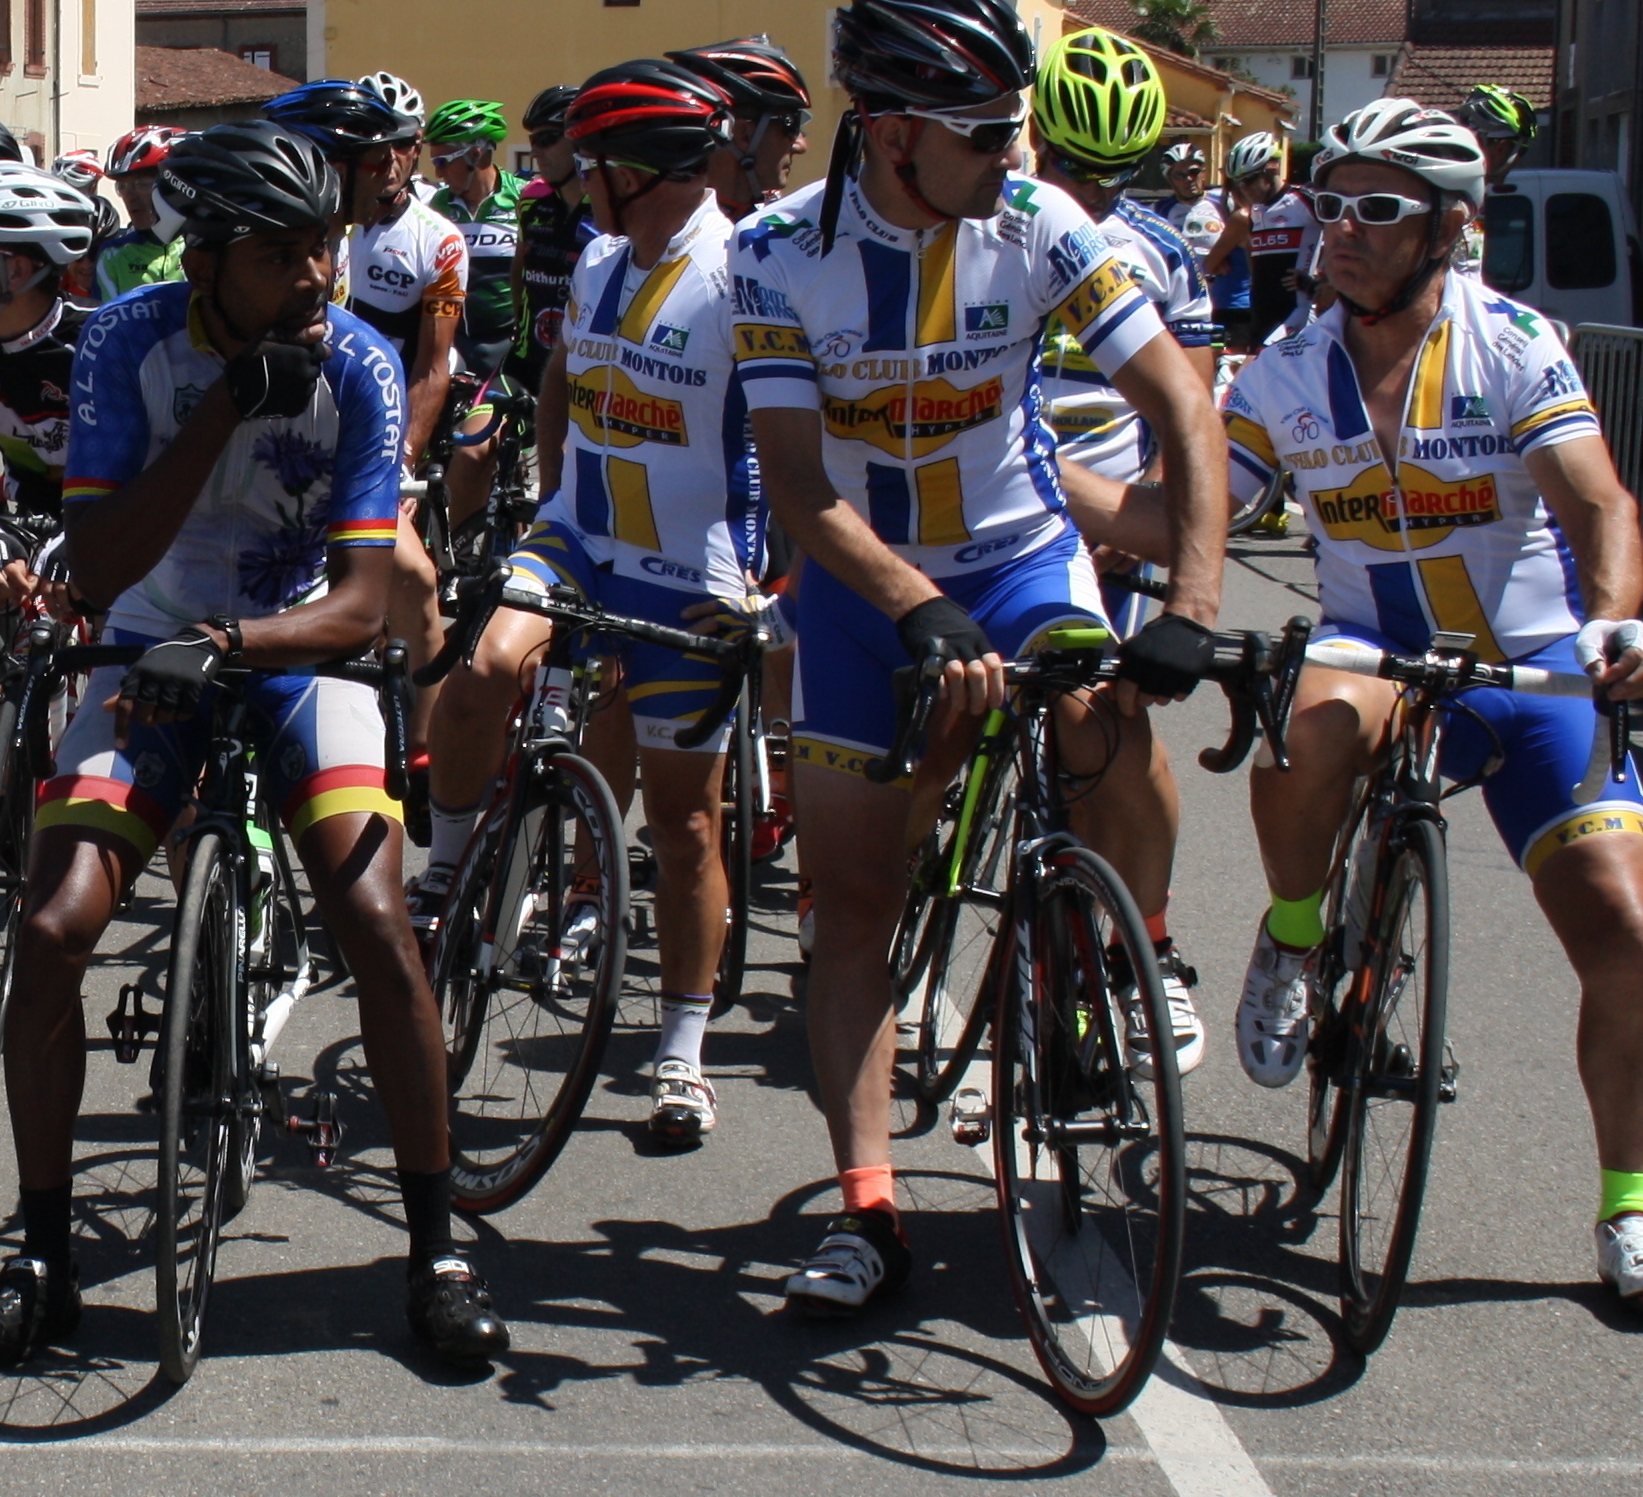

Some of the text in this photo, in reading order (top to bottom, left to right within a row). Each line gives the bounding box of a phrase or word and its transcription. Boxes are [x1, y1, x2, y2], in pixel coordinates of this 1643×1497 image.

[170, 177, 197, 199] GIRO
[464, 233, 515, 246] ODA
[367, 265, 415, 289] GCP
[525, 270, 572, 286] Dithurb
[79, 301, 162, 362] TOSTAT
[965, 329, 1008, 341] AQUITAINE
[621, 346, 707, 388] MONTOIS
[852, 358, 921, 381] CLUB
[362, 347, 406, 466] TOSTAT
[567, 378, 682, 432] ntermarché
[606, 420, 670, 442] HYPER
[1313, 480, 1494, 534] Intermarché
[1406, 513, 1481, 529] HYPER
[639, 556, 703, 583] CRES
[393, 695, 405, 752] ULTEGRA
[1556, 816, 1625, 846] V.C.M
[236, 904, 247, 985] PINARELLO
